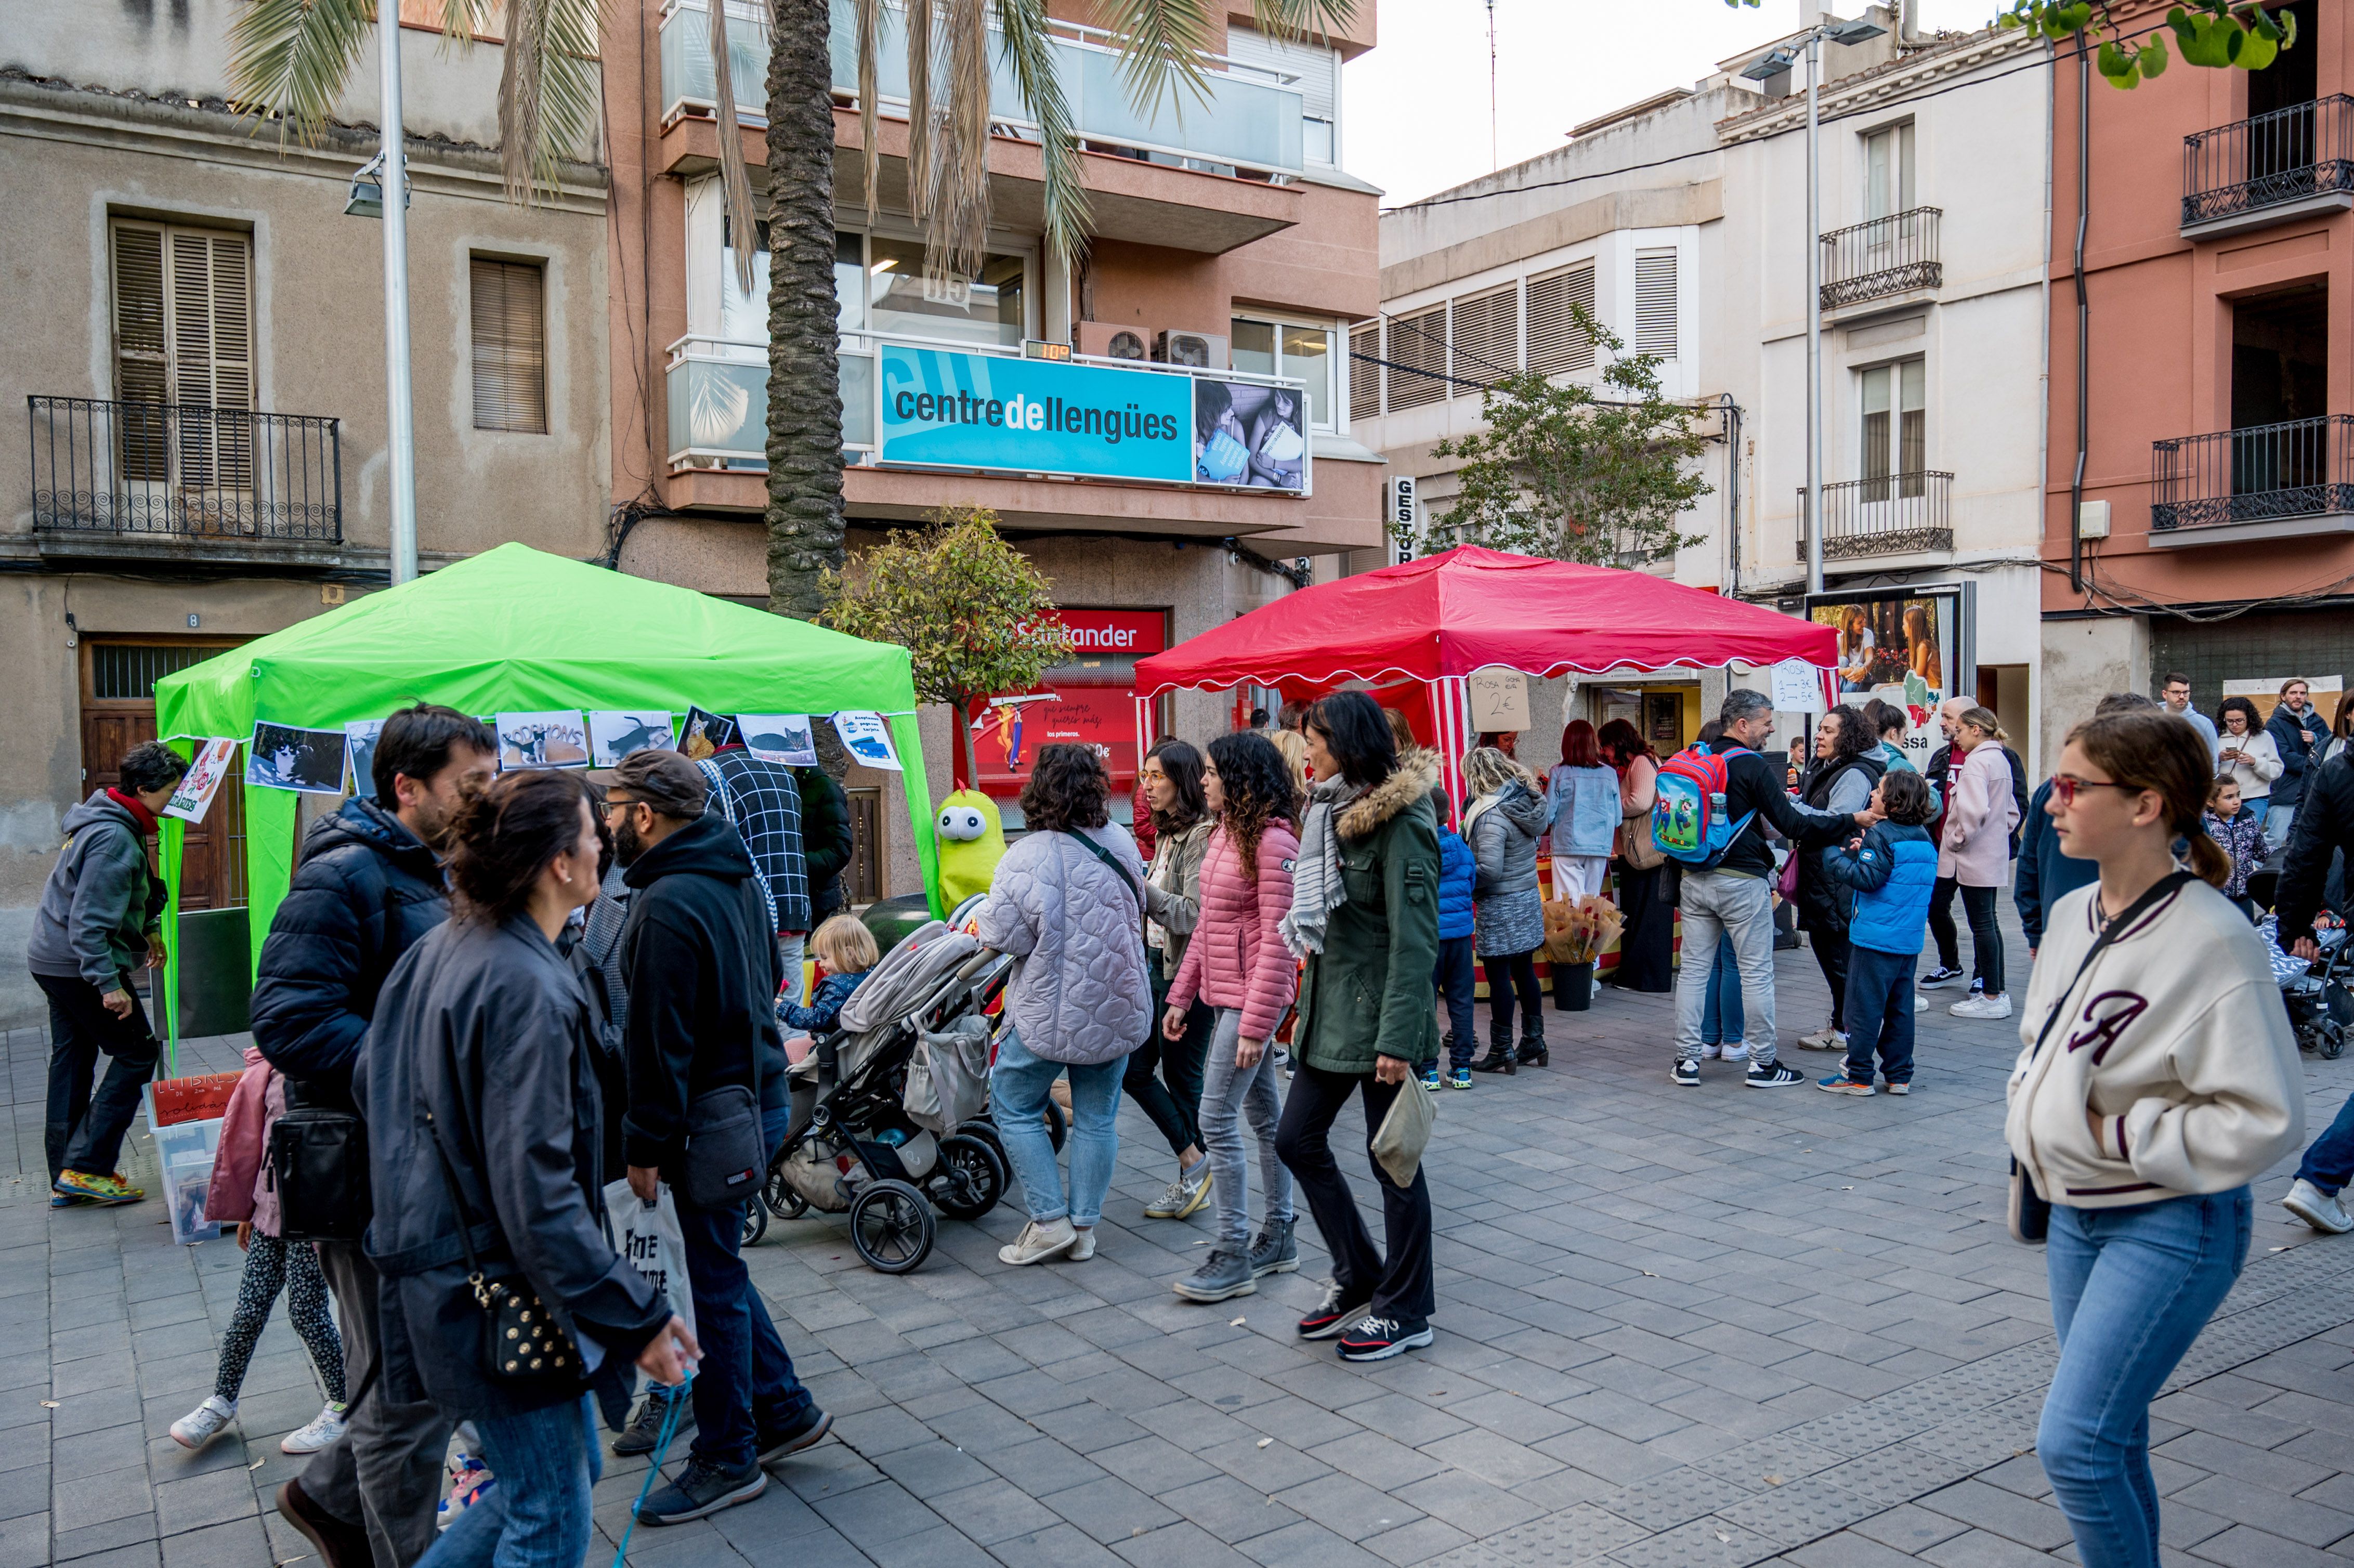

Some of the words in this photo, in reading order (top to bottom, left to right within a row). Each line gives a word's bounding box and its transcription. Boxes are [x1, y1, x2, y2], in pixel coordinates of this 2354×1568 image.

[895, 390, 1178, 445] centredellengües
[190, 614, 198, 627] 8
[1778, 662, 1806, 675] ROSA
[1473, 676, 1499, 689] ROSA
[1778, 680, 1785, 690] 1
[1800, 679, 1812, 689] 3€
[1780, 692, 1786, 702] 2
[1801, 691, 1814, 702] 5€
[1490, 692, 1515, 716] 2€
[1044, 705, 1057, 722] que
[1058, 703, 1091, 715] siempre
[1052, 715, 1081, 729] quieres
[2067, 989, 2149, 1066] A
